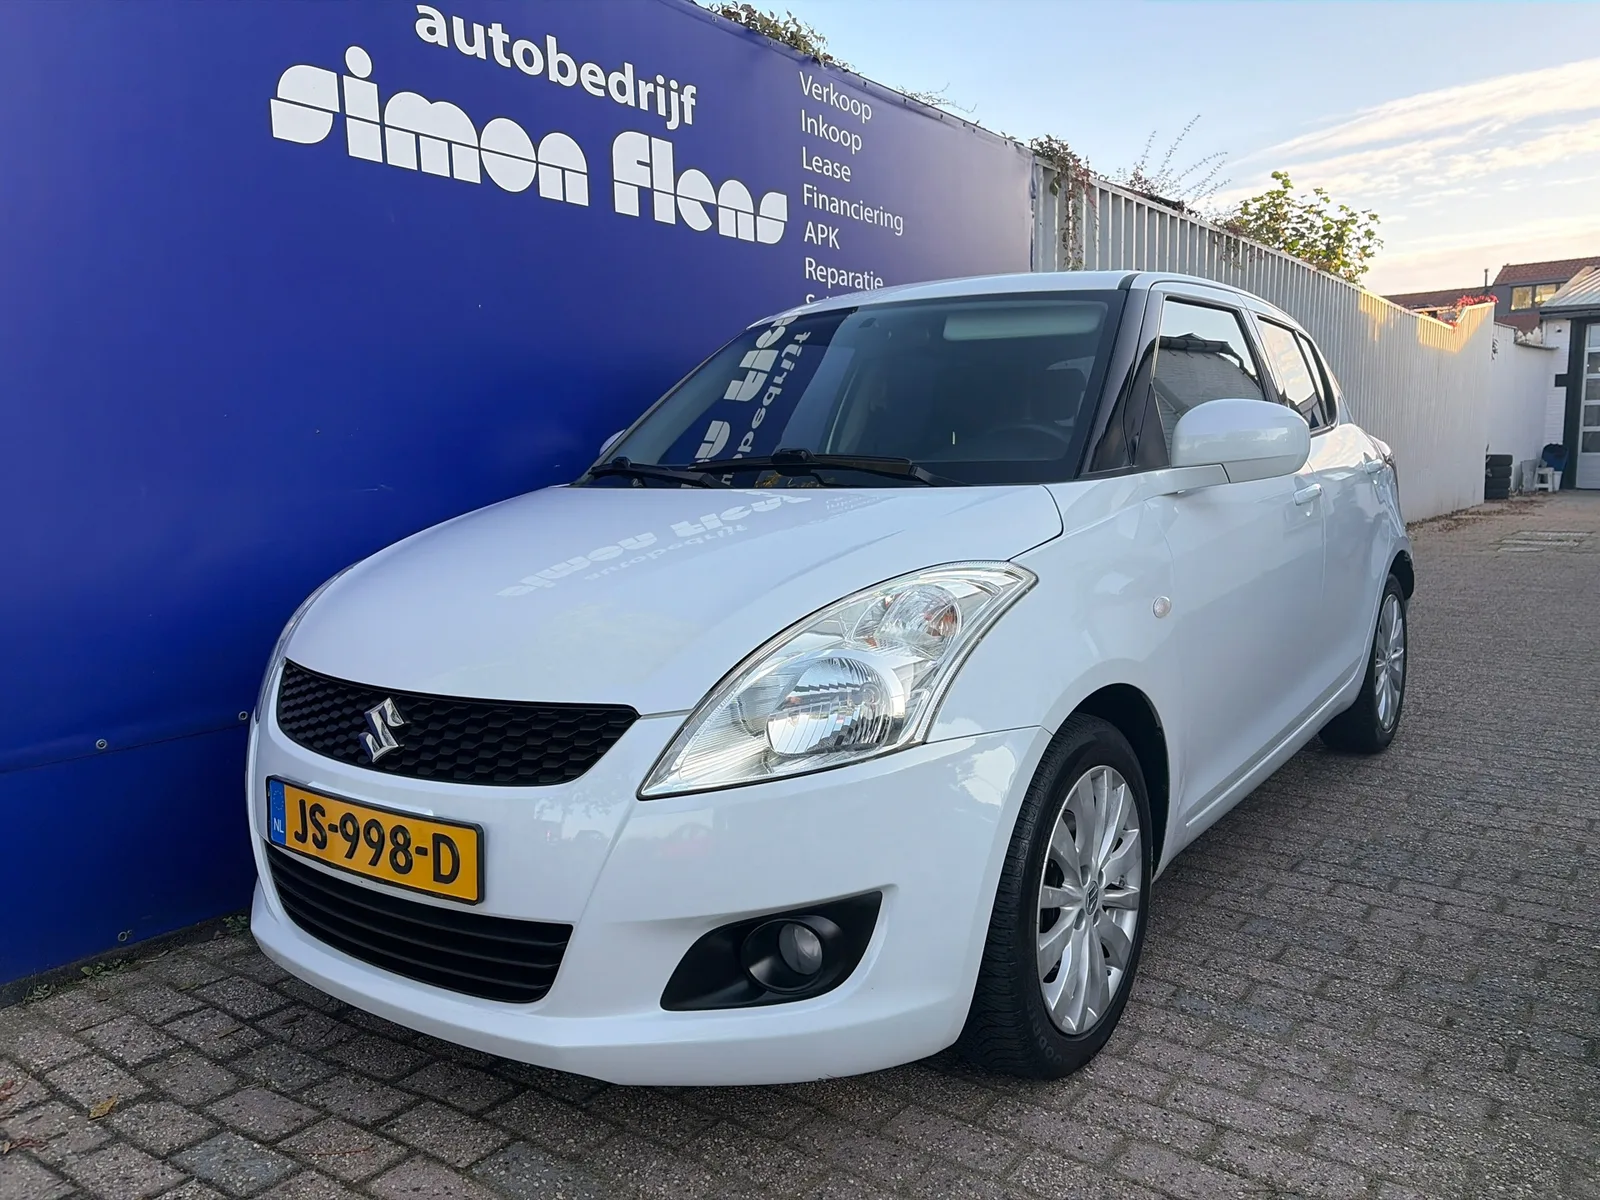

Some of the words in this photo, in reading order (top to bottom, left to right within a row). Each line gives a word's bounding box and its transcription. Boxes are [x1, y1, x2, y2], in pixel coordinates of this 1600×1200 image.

[415, 4, 697, 131] autobedrijf
[799, 71, 872, 124] Verkoop
[801, 109, 862, 154] Inkoop
[802, 146, 851, 182] Lease
[803, 183, 904, 236] Financiering
[804, 221, 840, 250] APK
[805, 257, 884, 291] Reparatie
[273, 817, 285, 833] NL
[294, 799, 461, 884] JS-998-D
